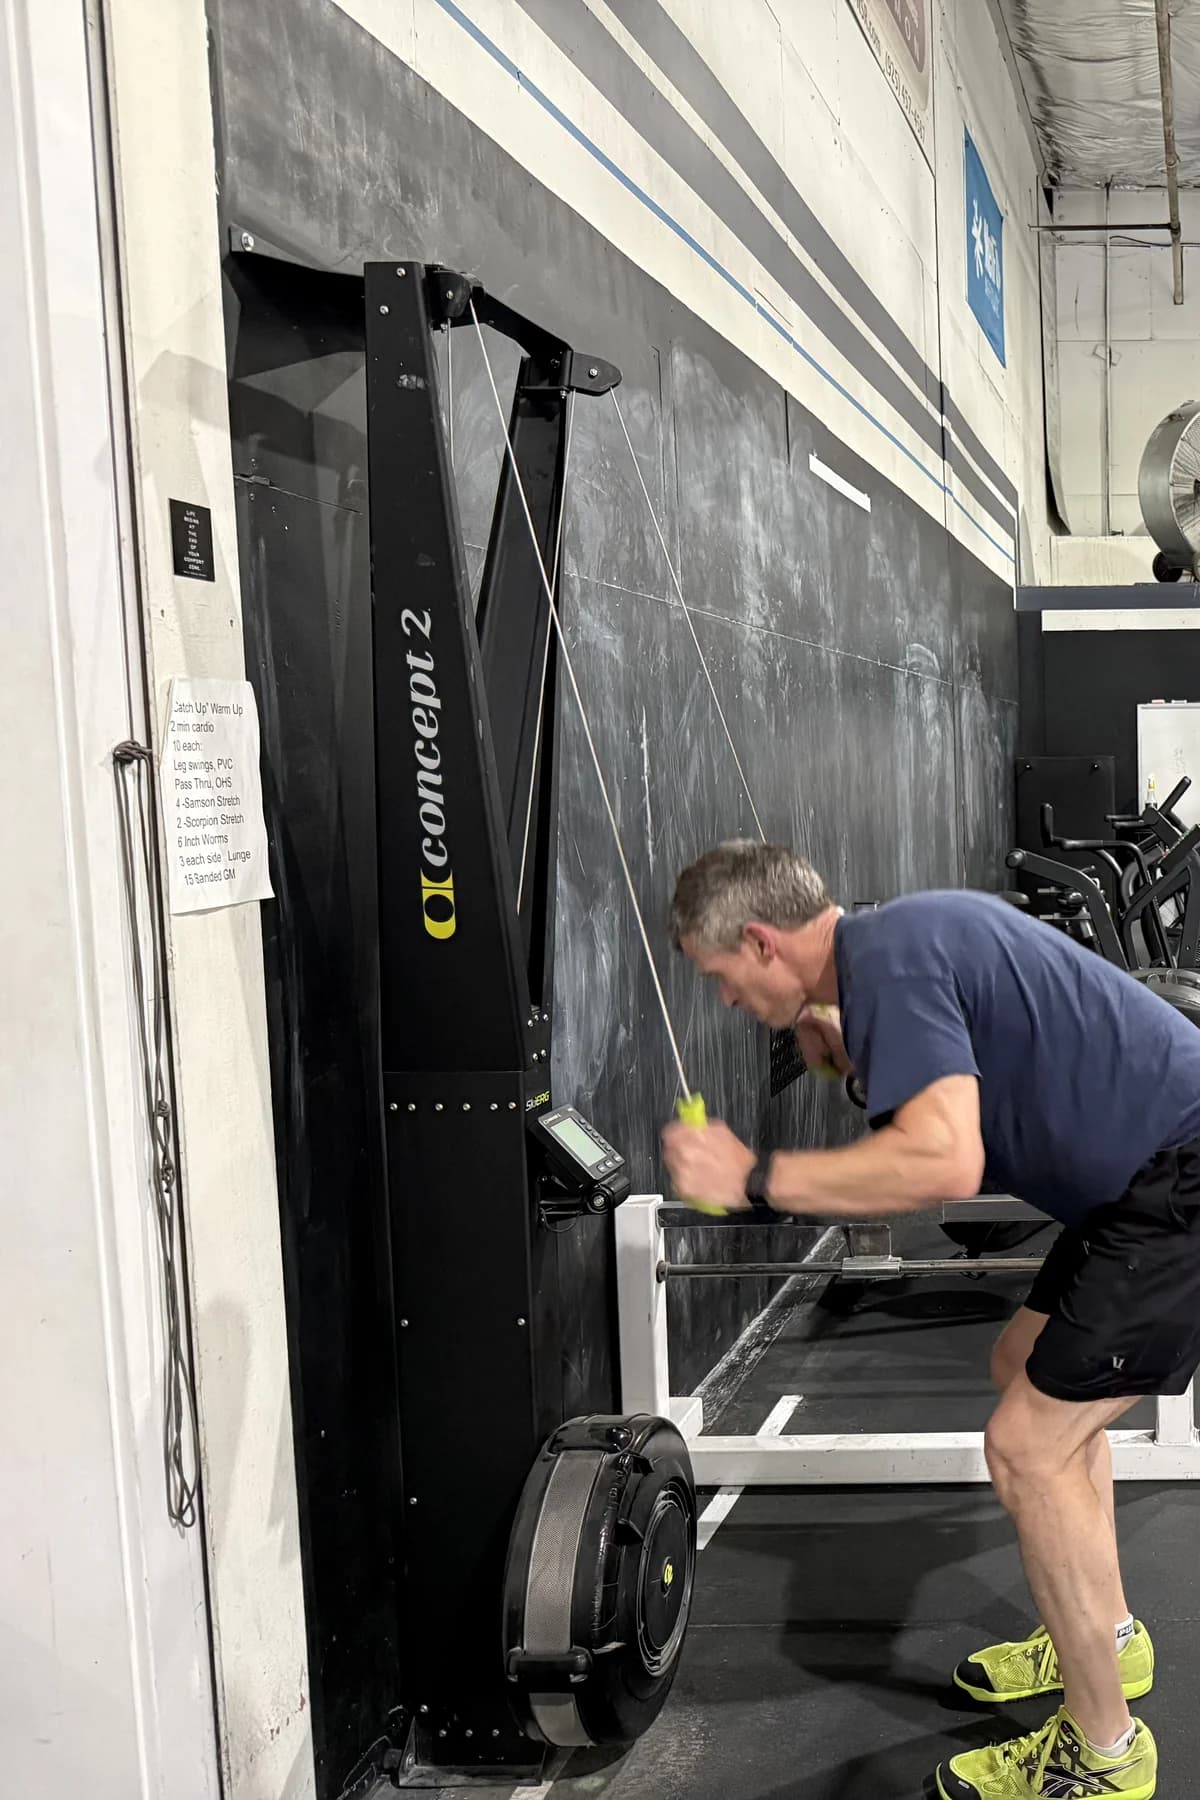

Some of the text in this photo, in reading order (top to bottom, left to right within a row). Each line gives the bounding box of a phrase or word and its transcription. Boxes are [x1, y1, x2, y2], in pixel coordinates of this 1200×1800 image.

[211, 703, 231, 715] Warm
[232, 704, 243, 716] Up
[170, 720, 214, 733] 2 min cardio
[401, 608, 449, 867] concept 2
[173, 740, 181, 752] 10
[173, 758, 233, 773] Leg swings, PVC
[175, 777, 232, 790] Pass Thru, OHS
[175, 798, 180, 808] 4
[217, 795, 241, 807] Stretch
[176, 817, 182, 828] 2
[220, 813, 244, 825] Stretch
[177, 833, 229, 848] 6 Inch Worms
[179, 850, 251, 867] 3 each side Lunge
[184, 868, 236, 886] 15 Banded GM
